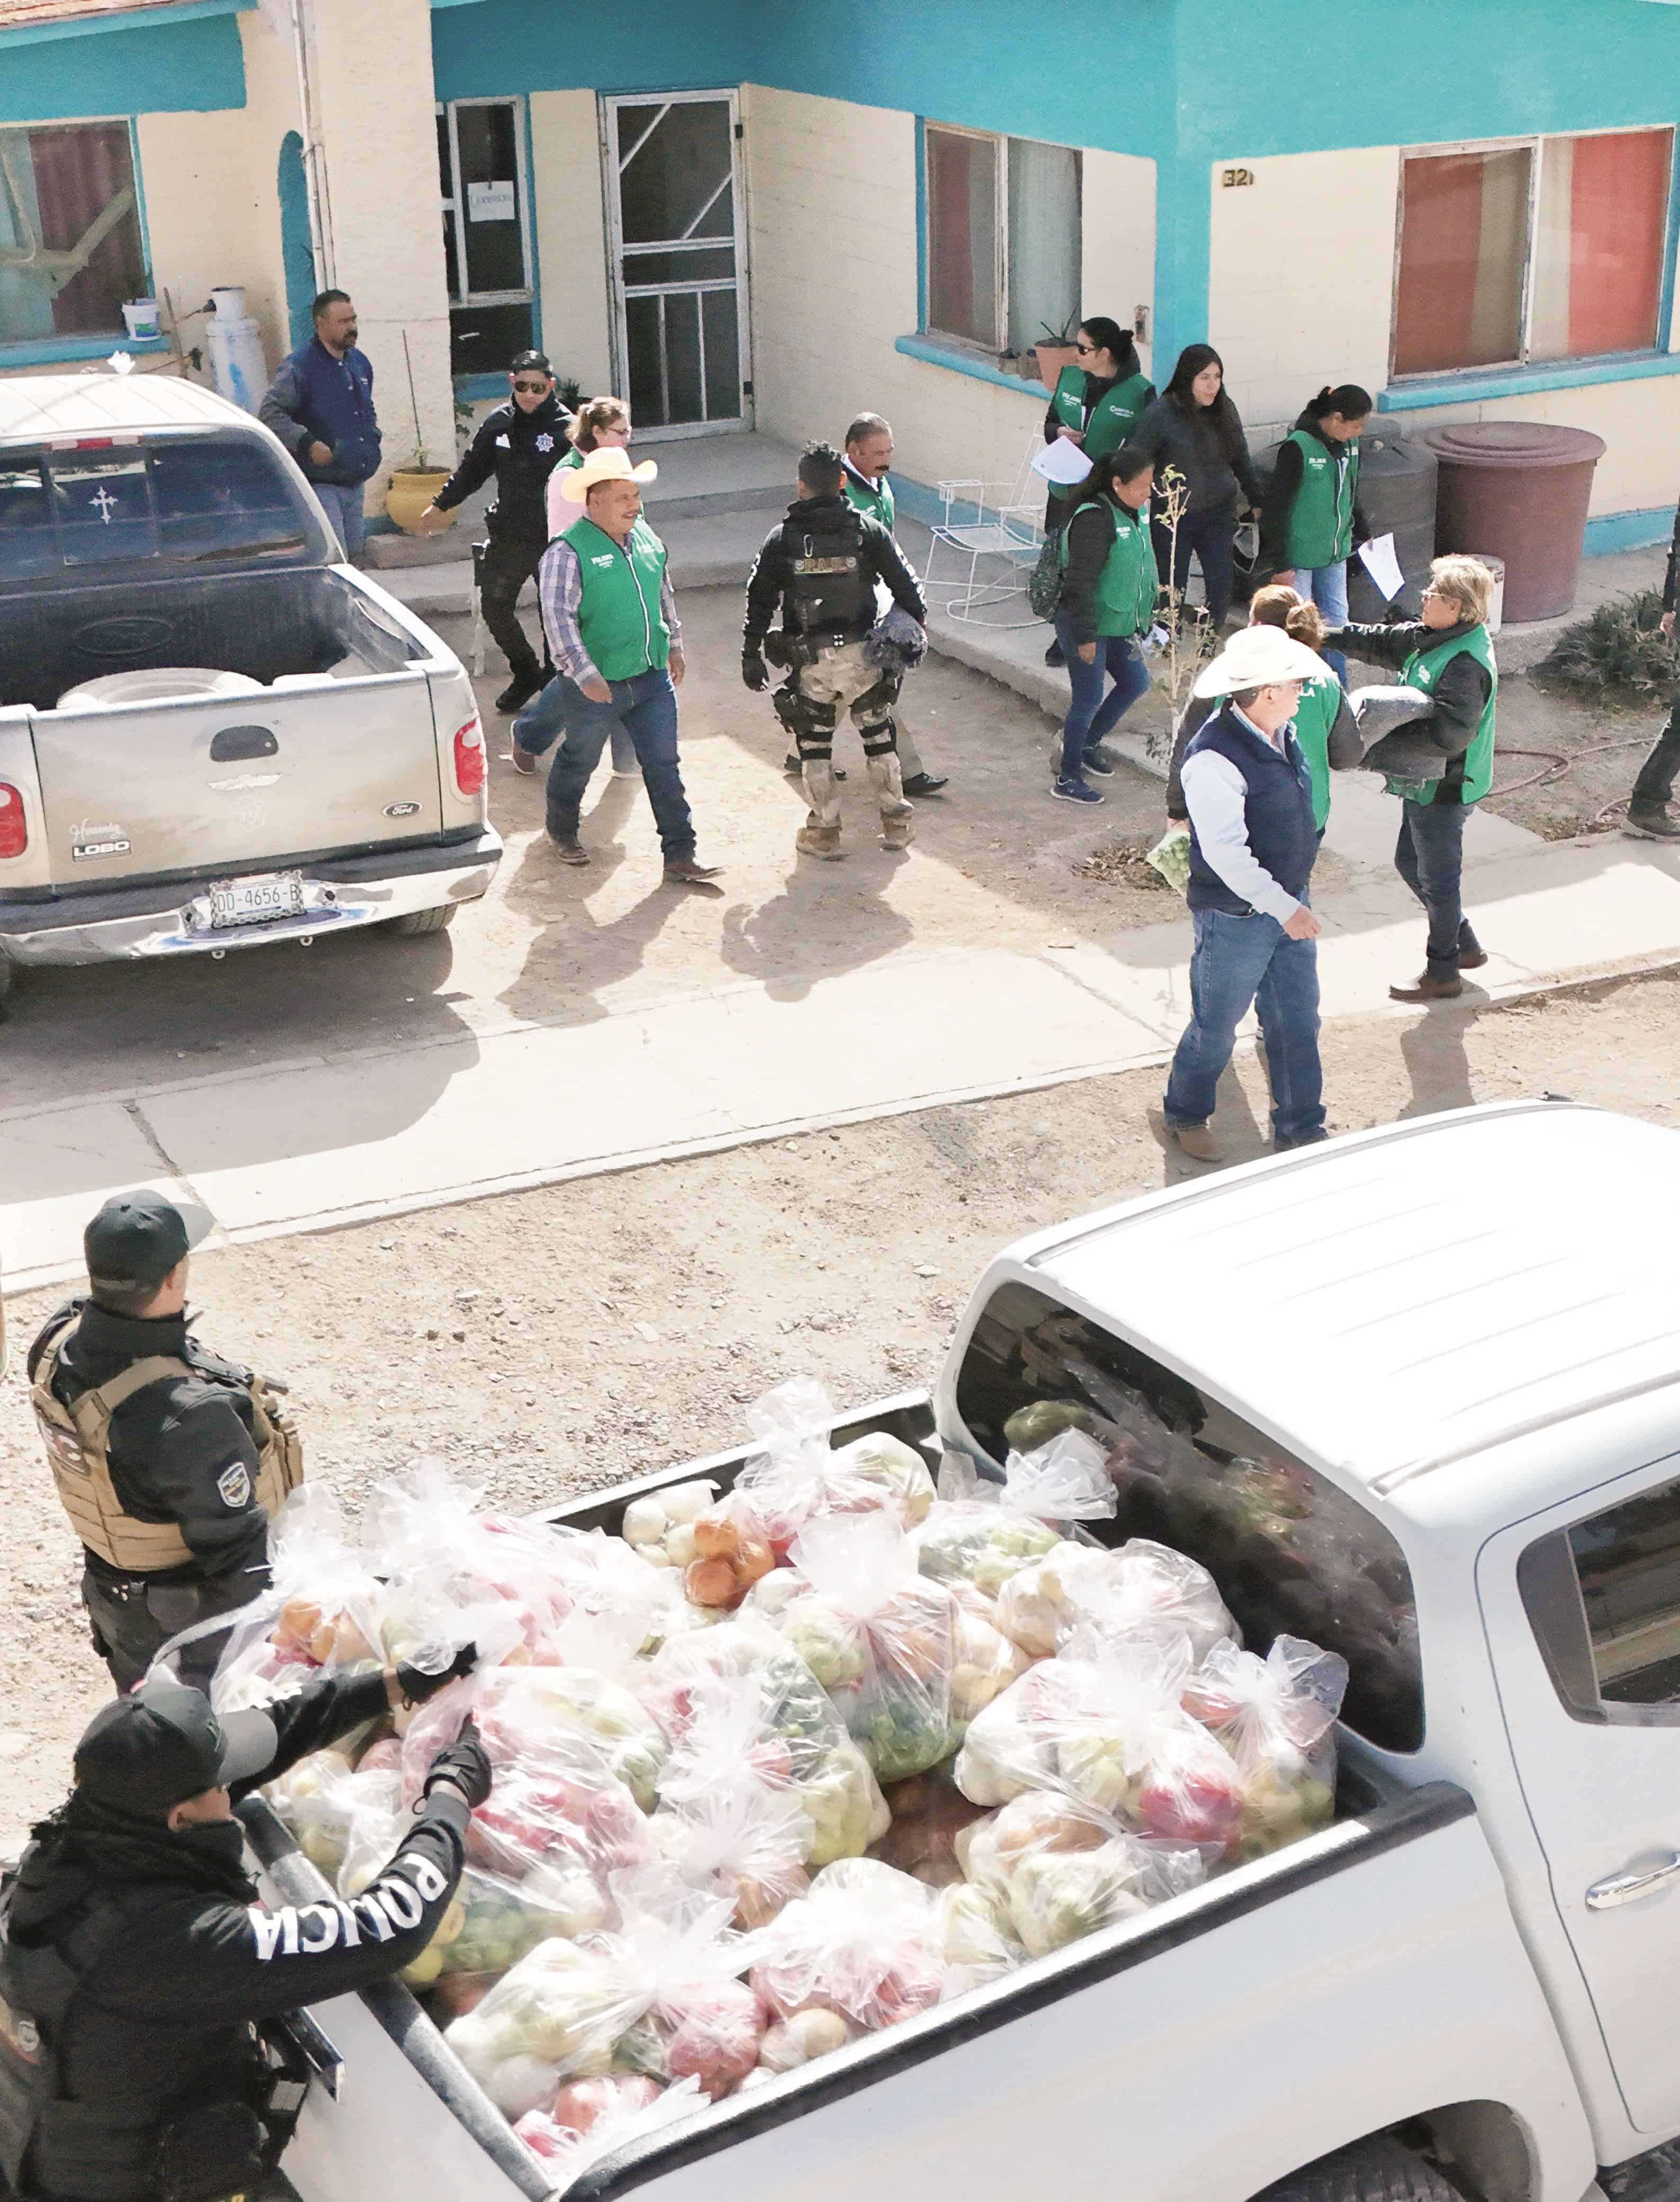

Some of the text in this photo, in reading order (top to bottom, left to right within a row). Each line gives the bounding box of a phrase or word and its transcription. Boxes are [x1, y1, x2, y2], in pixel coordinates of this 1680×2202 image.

[392, 805, 413, 815] Ford
[74, 841, 130, 857] LOBO
[247, 1852, 449, 1960] POLICIA
